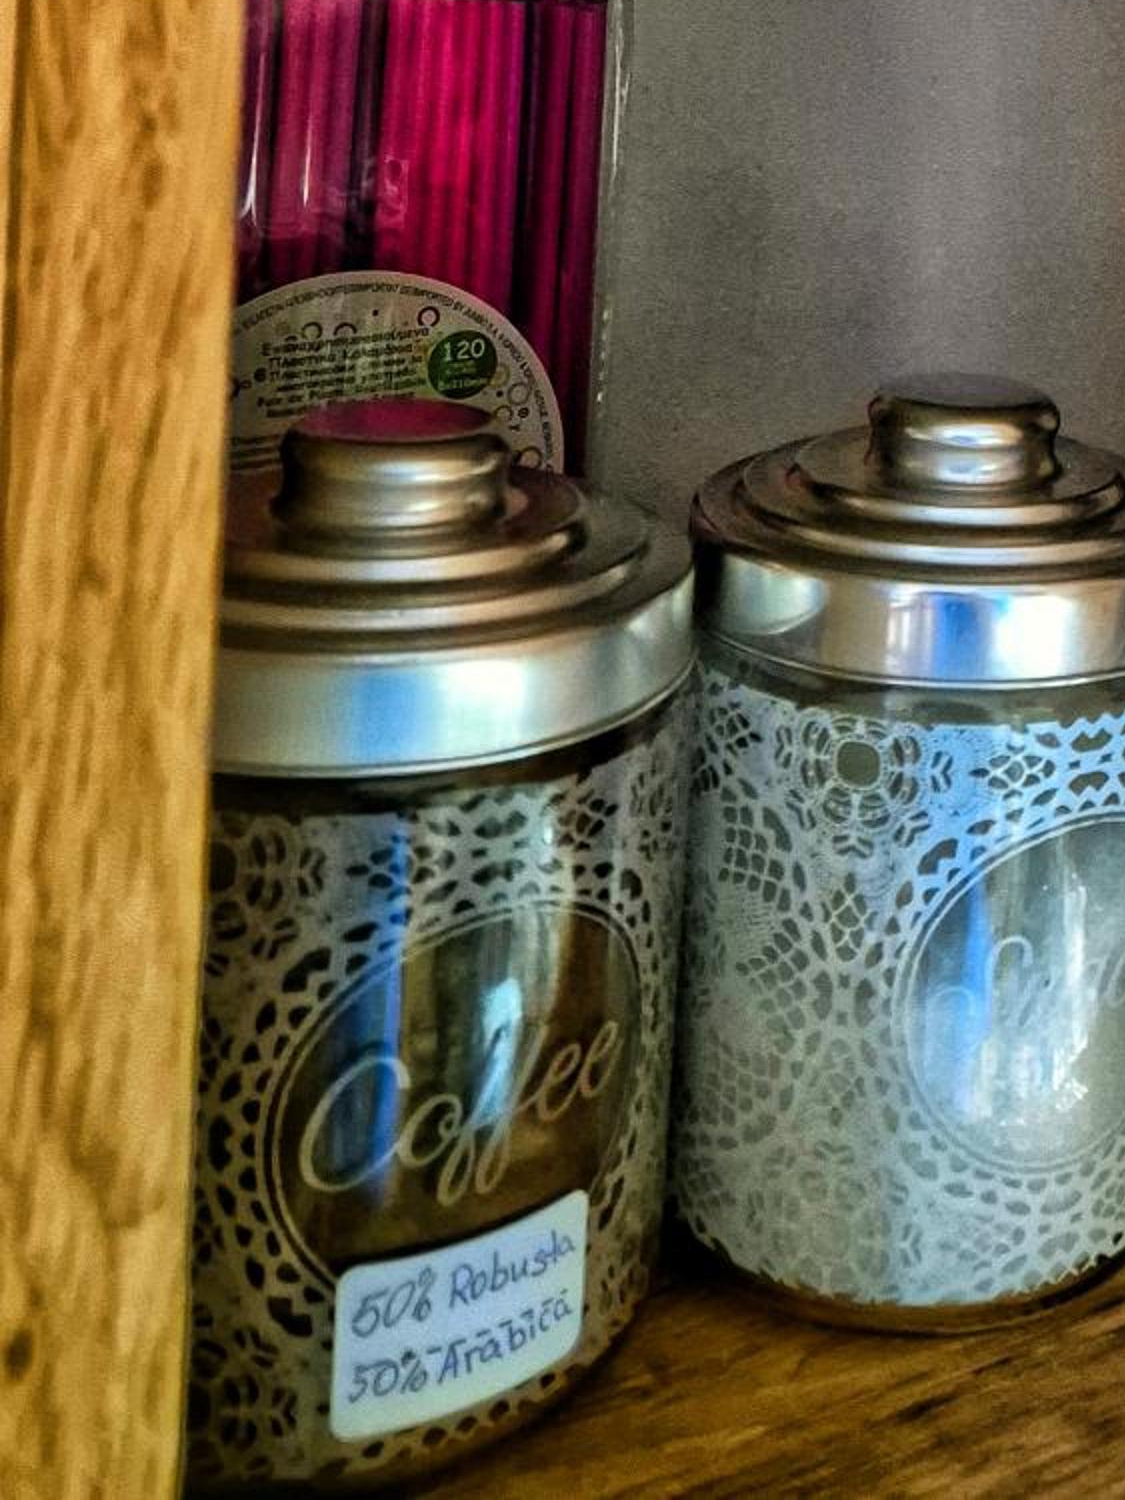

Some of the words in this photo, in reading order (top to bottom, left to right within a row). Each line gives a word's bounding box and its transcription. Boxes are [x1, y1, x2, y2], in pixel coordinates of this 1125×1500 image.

[445, 338, 485, 361] 120
[300, 1020, 621, 1206] Coffee
[351, 1265, 438, 1339] 50%
[450, 1229, 577, 1309] Robusta
[349, 1350, 428, 1404] 50%
[437, 1296, 574, 1385] Arabica
